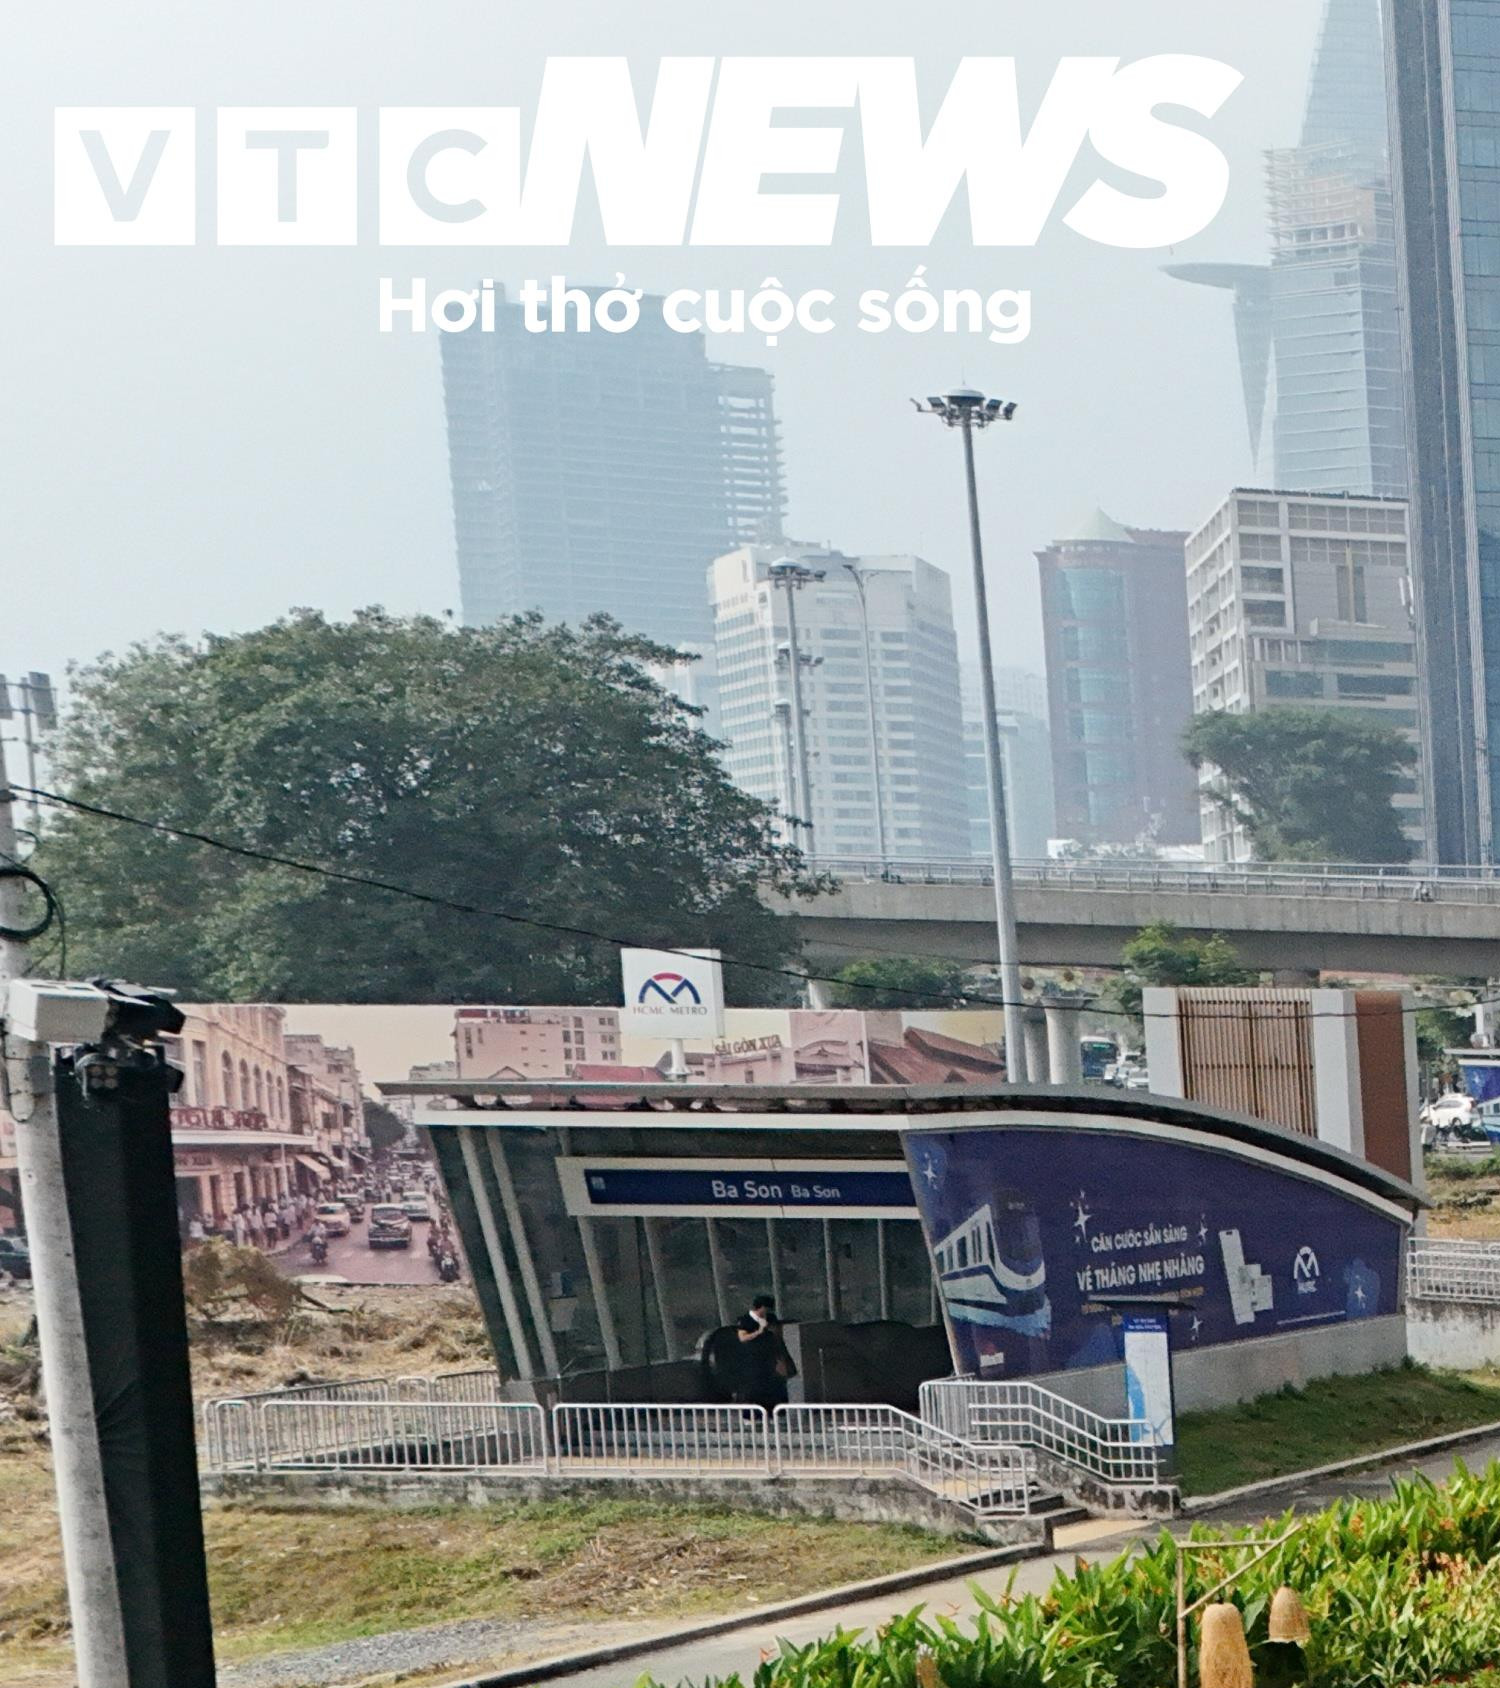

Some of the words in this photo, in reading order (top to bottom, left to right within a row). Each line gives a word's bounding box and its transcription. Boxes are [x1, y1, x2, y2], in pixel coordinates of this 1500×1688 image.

[632, 1006, 665, 1016] HCMC
[670, 1006, 708, 1016] METRO
[711, 1179, 738, 1199] Ba
[743, 1180, 783, 1199] Son
[791, 1184, 811, 1199] Ba
[812, 1185, 841, 1199] Son
[1094, 1261, 1136, 1290] THÁNG
[1138, 1261, 1162, 1287] NHẸ
[1163, 1252, 1206, 1280] NHÀNG
